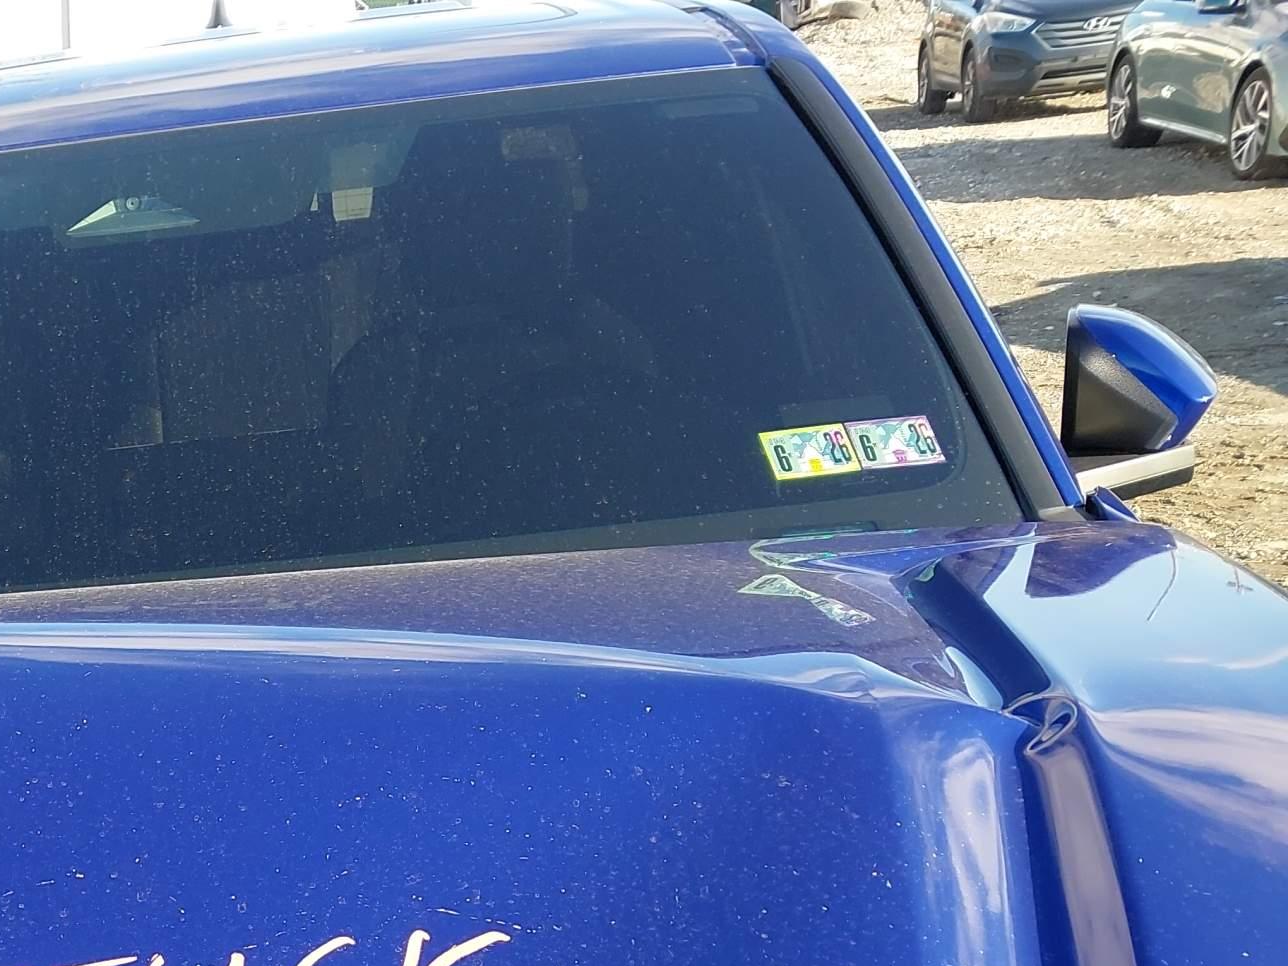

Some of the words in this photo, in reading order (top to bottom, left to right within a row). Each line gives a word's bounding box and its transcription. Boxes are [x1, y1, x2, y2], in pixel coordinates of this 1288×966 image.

[773, 444, 793, 472] 6
[823, 431, 852, 463] 26
[858, 434, 877, 461] 6
[908, 423, 937, 454] 26
